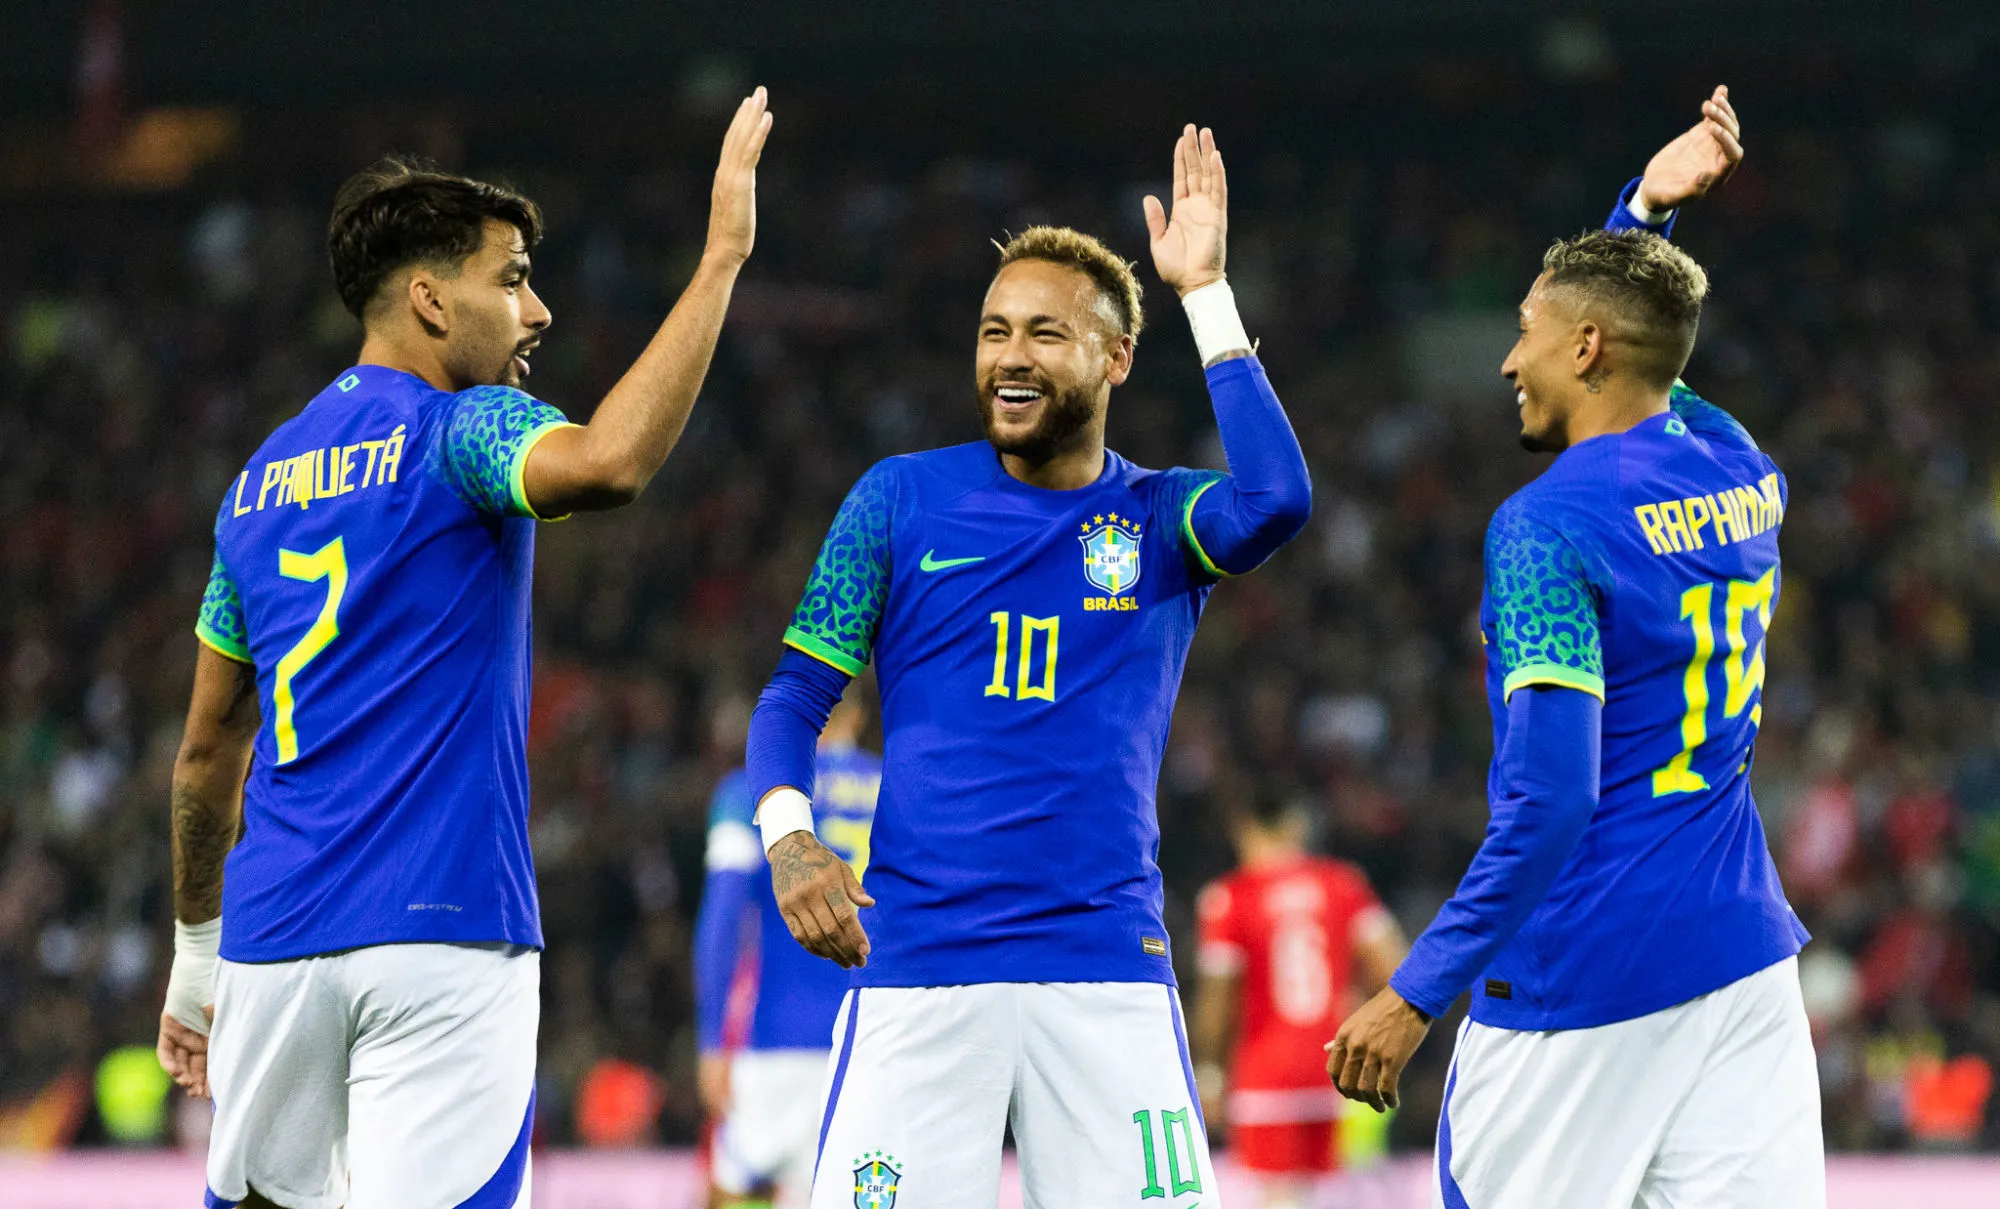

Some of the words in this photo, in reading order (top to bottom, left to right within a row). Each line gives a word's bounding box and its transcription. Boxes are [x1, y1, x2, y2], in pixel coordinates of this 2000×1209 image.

[256, 423, 406, 511] PAQUETÁ
[1083, 596, 1139, 611] BRASIL
[1101, 555, 1123, 564] CBF
[273, 535, 348, 766] 7
[984, 611, 1060, 702] 10
[867, 1184, 884, 1193] CBF
[1132, 1107, 1203, 1200] 10
